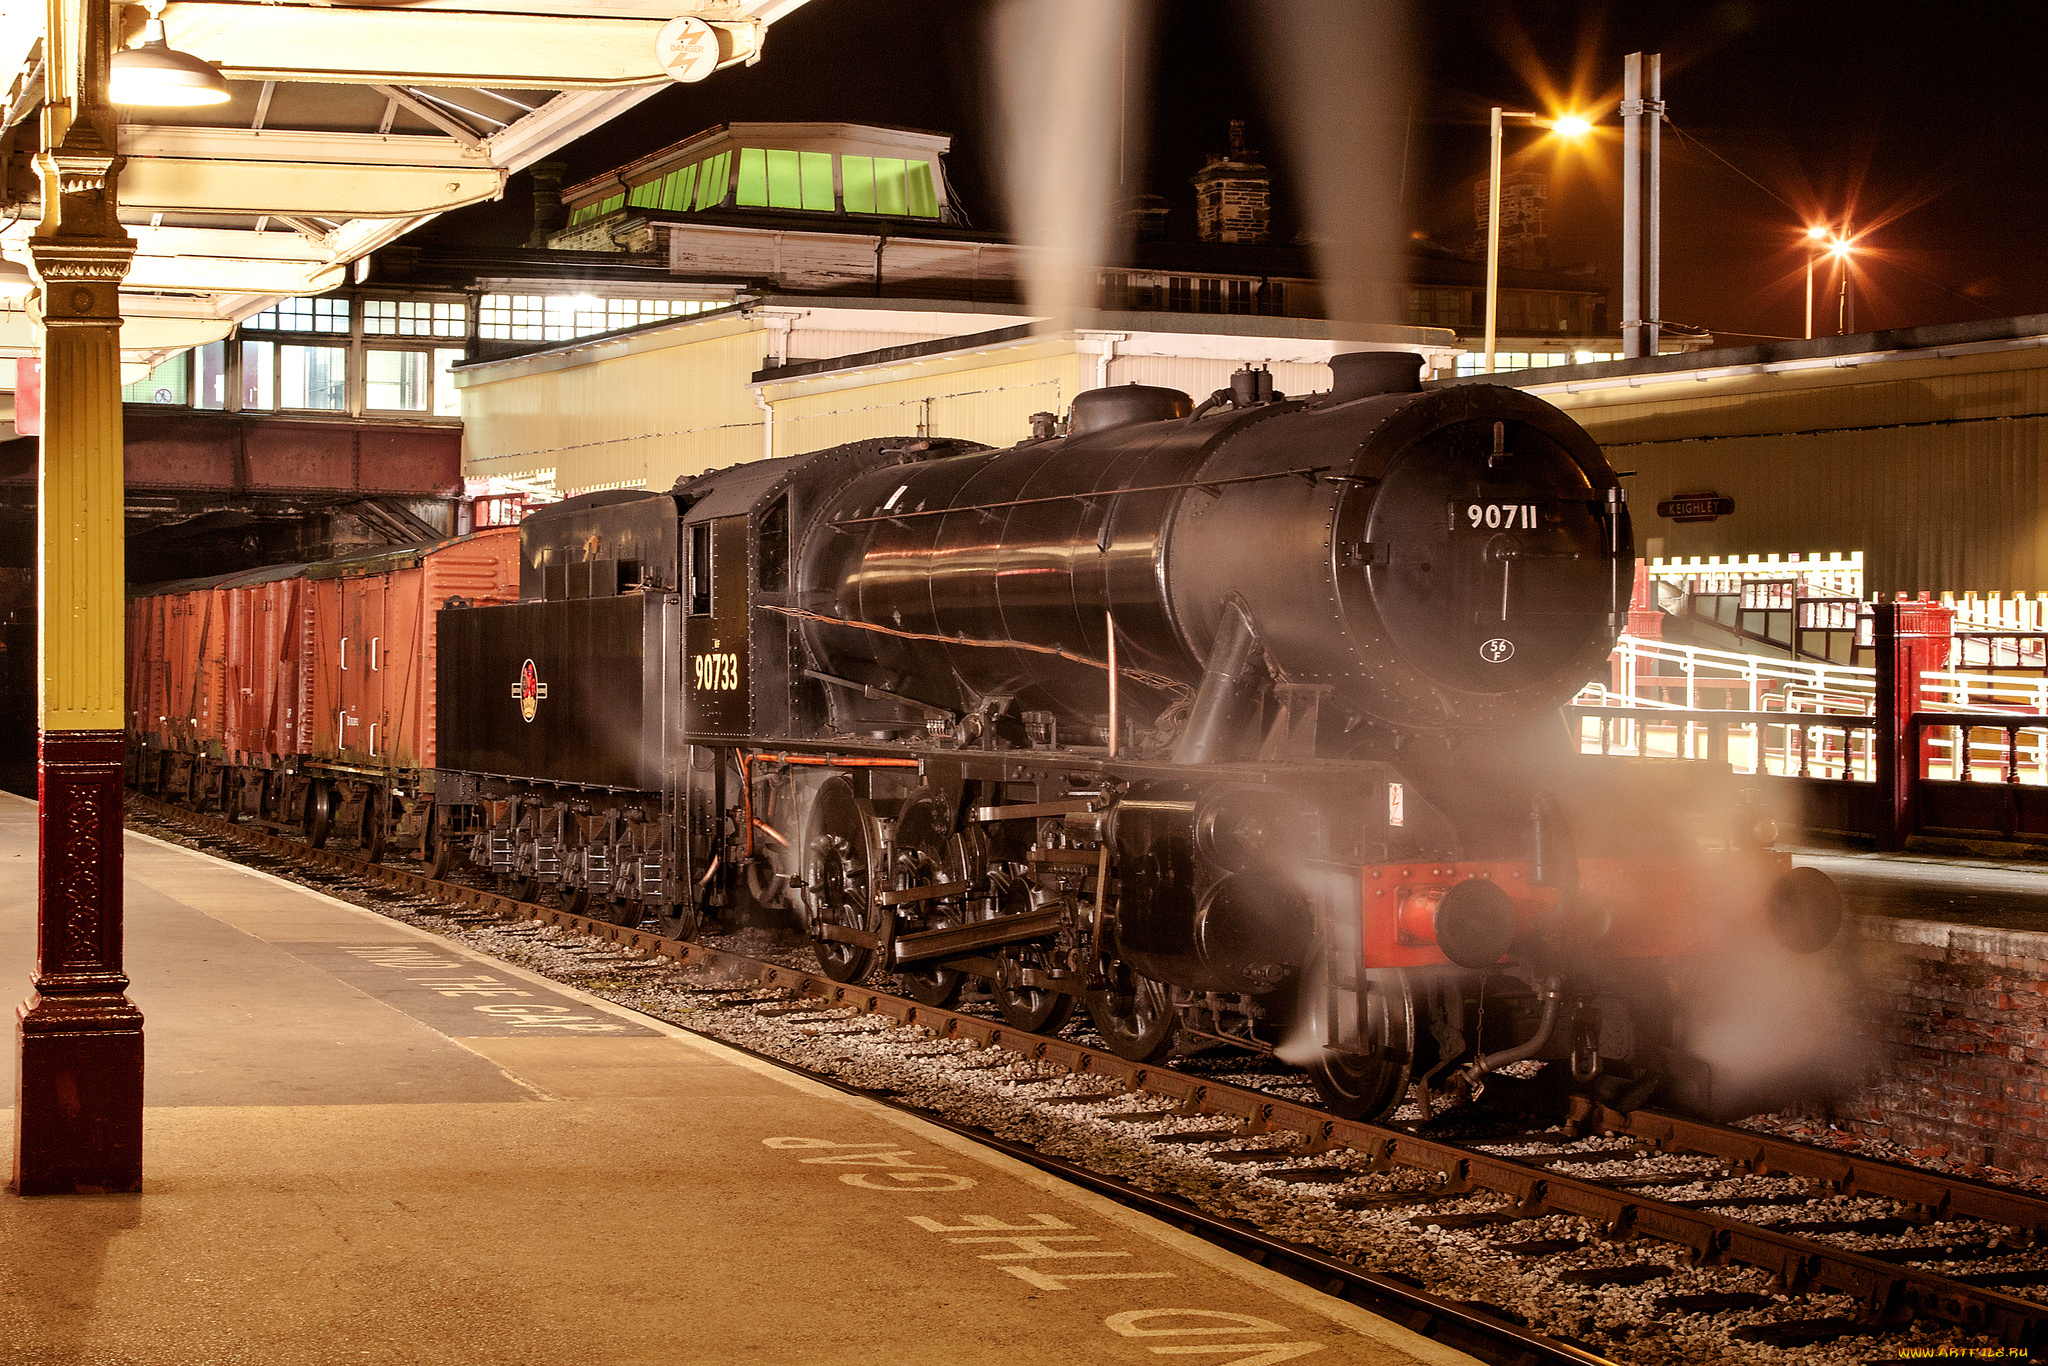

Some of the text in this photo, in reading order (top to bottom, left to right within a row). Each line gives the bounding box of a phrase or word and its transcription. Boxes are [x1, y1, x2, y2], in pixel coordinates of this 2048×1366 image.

[670, 44, 704, 53] DANGER
[1467, 504, 1537, 529] 90711
[1668, 501, 1719, 515] KEIGHLEY
[1490, 640, 1507, 652] 56
[1493, 652, 1501, 661] F
[695, 653, 738, 691] 90733
[337, 946, 626, 1031] MIND THE GAP
[761, 1136, 979, 1192] GAP
[907, 1213, 1177, 1291] THE
